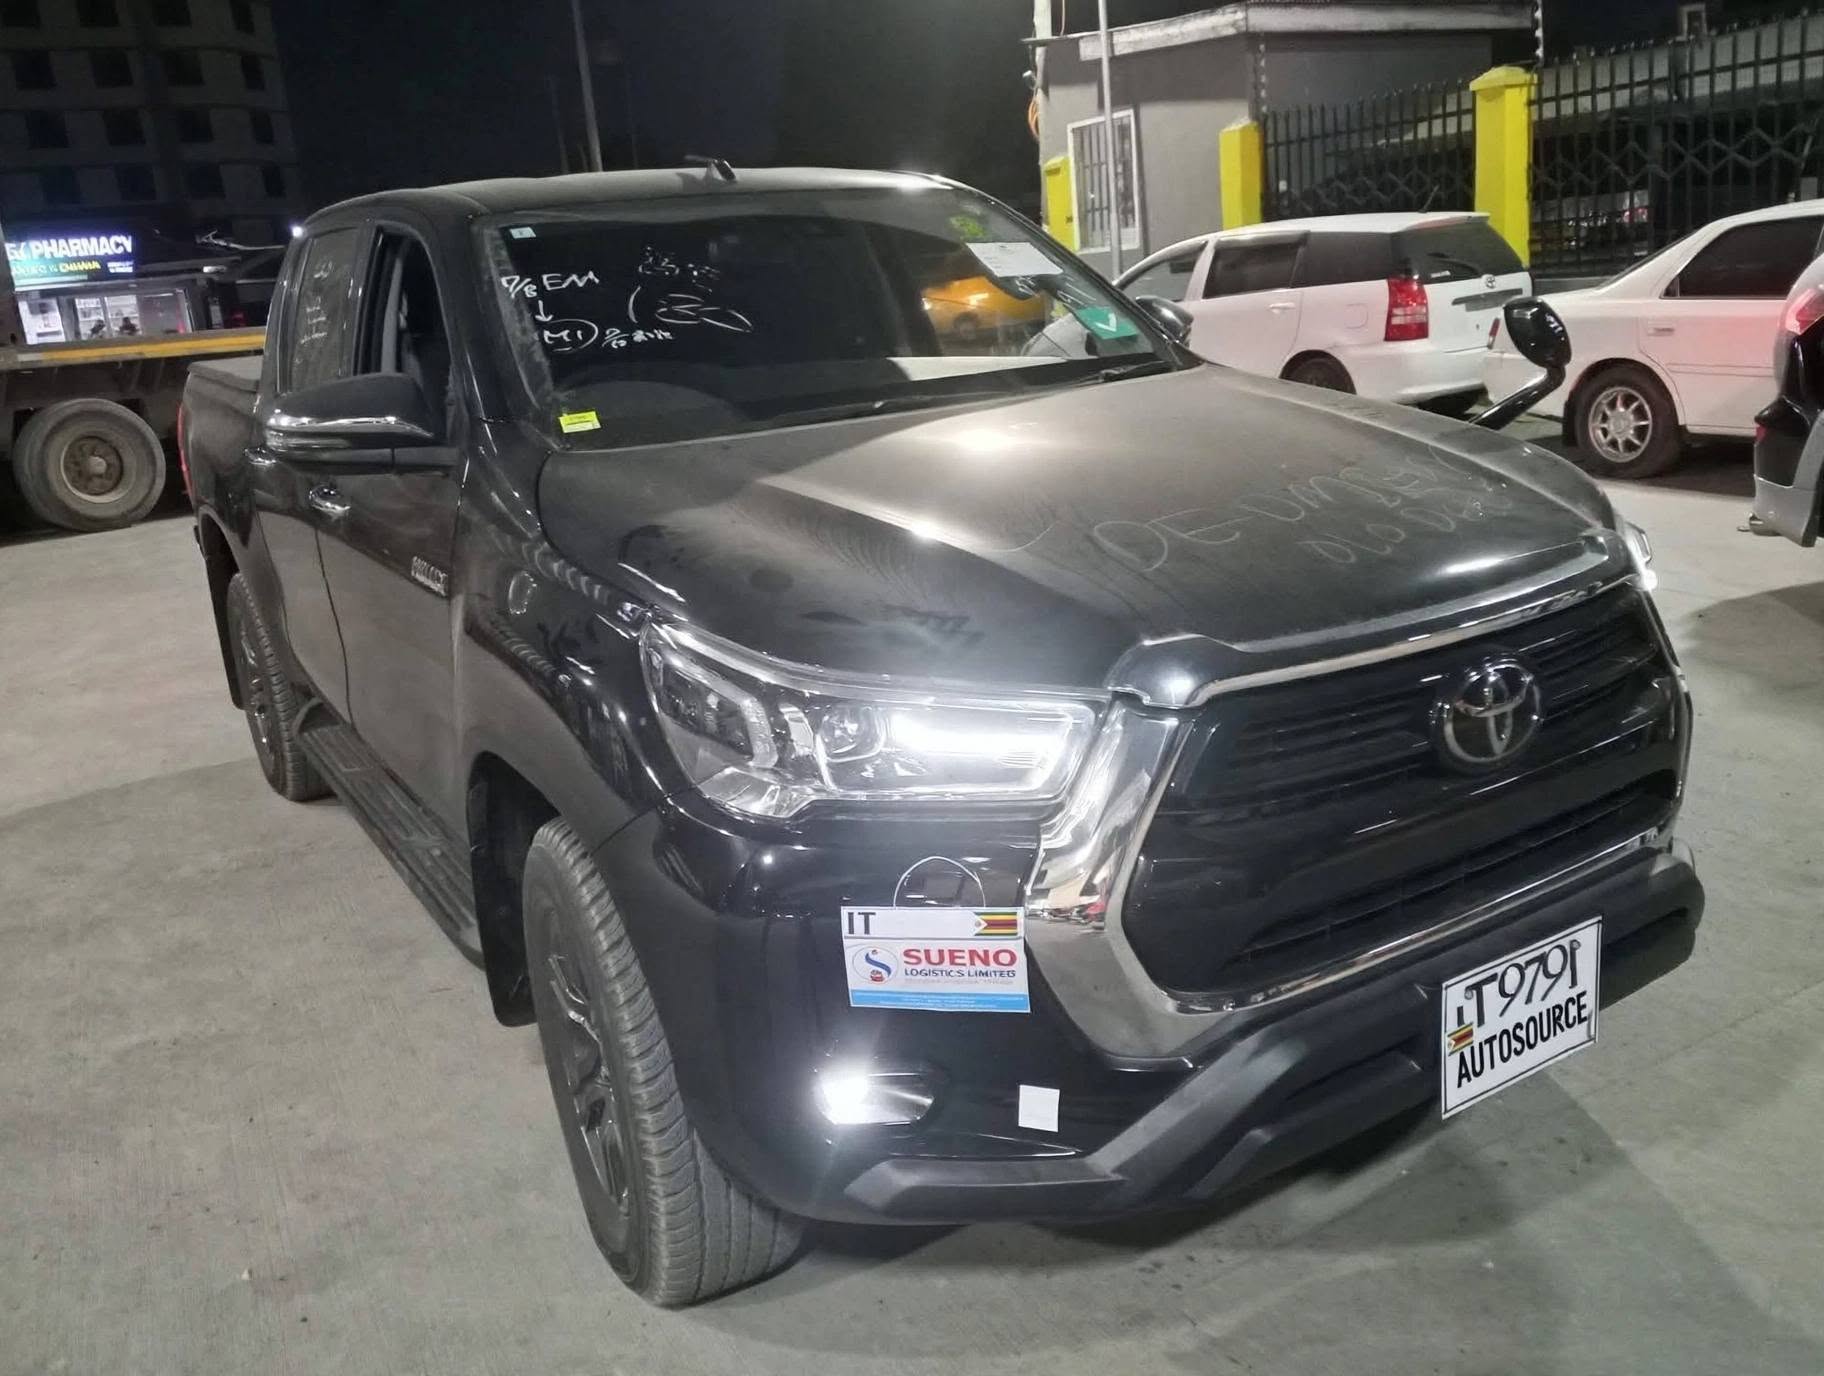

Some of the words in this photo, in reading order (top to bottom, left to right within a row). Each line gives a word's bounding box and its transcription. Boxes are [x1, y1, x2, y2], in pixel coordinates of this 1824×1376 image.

[29, 235, 132, 258] PHARMACY
[847, 911, 876, 935] IT
[903, 948, 1017, 967] SUENO
[904, 968, 965, 978] LOGISTICS
[1457, 990, 1588, 1089] AUTOSOURCE
